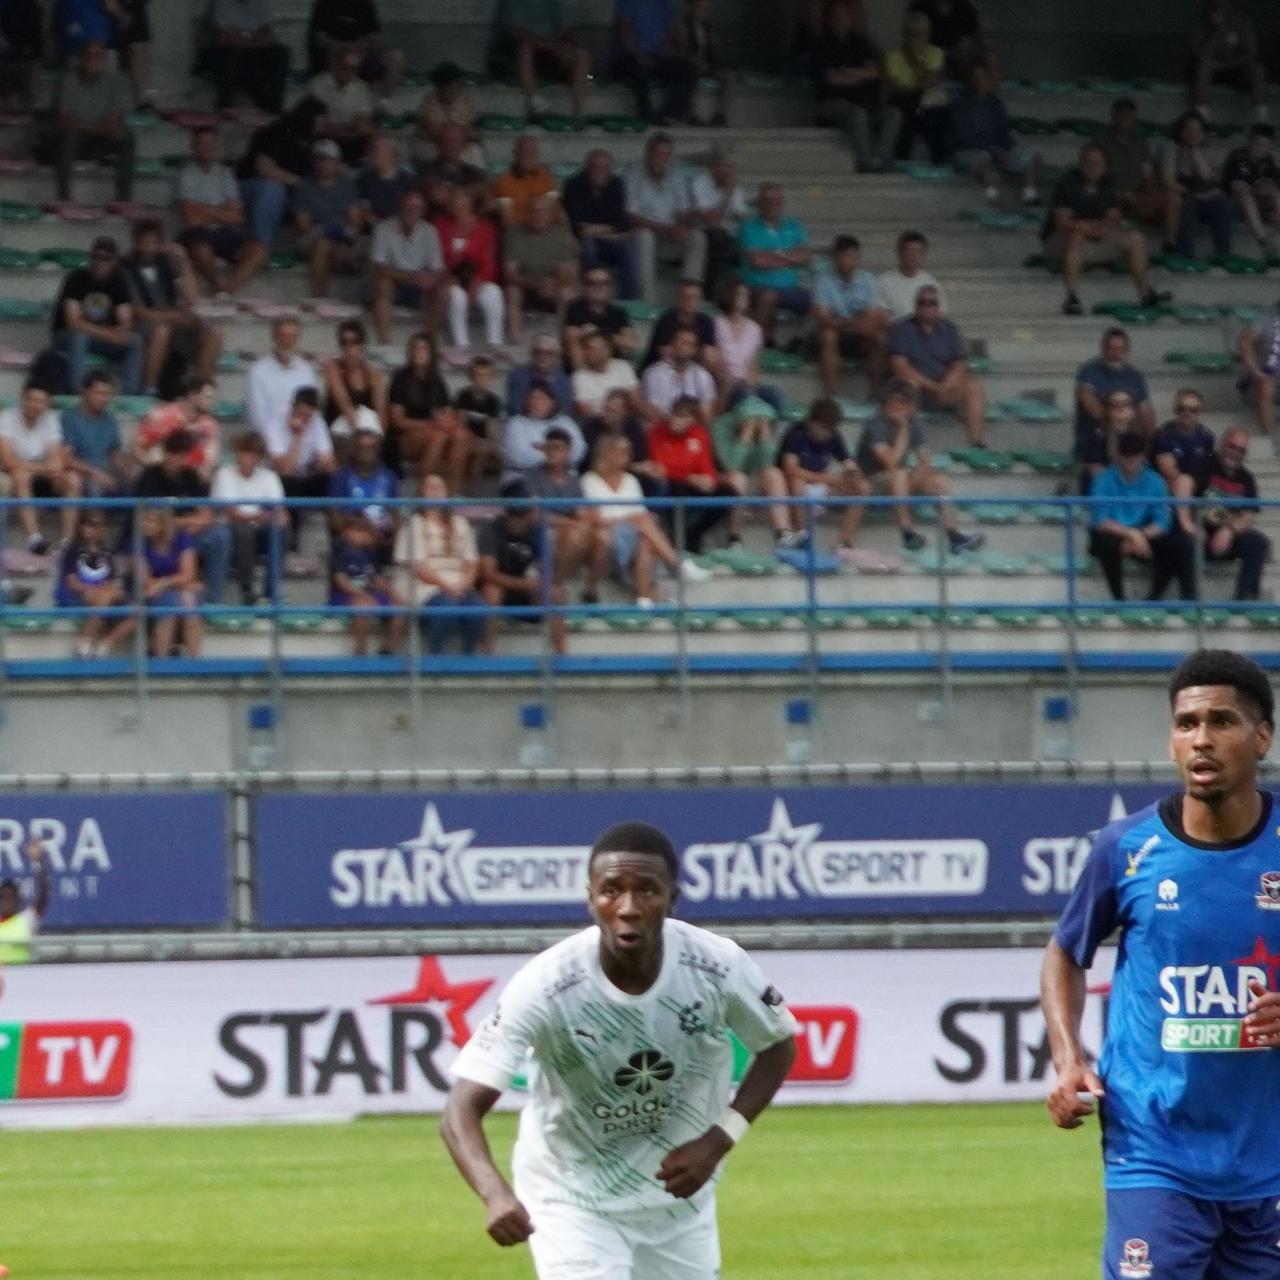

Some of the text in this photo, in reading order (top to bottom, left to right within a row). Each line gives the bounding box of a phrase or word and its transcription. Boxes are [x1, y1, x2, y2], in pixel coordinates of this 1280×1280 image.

[329, 847, 582, 907] STAR SPORT
[679, 841, 978, 901] STAR SPORT TV
[38, 1035, 122, 1085] TV
[212, 1004, 451, 1099] STAR
[793, 1020, 849, 1068] V
[1166, 1023, 1238, 1047] SPORT
